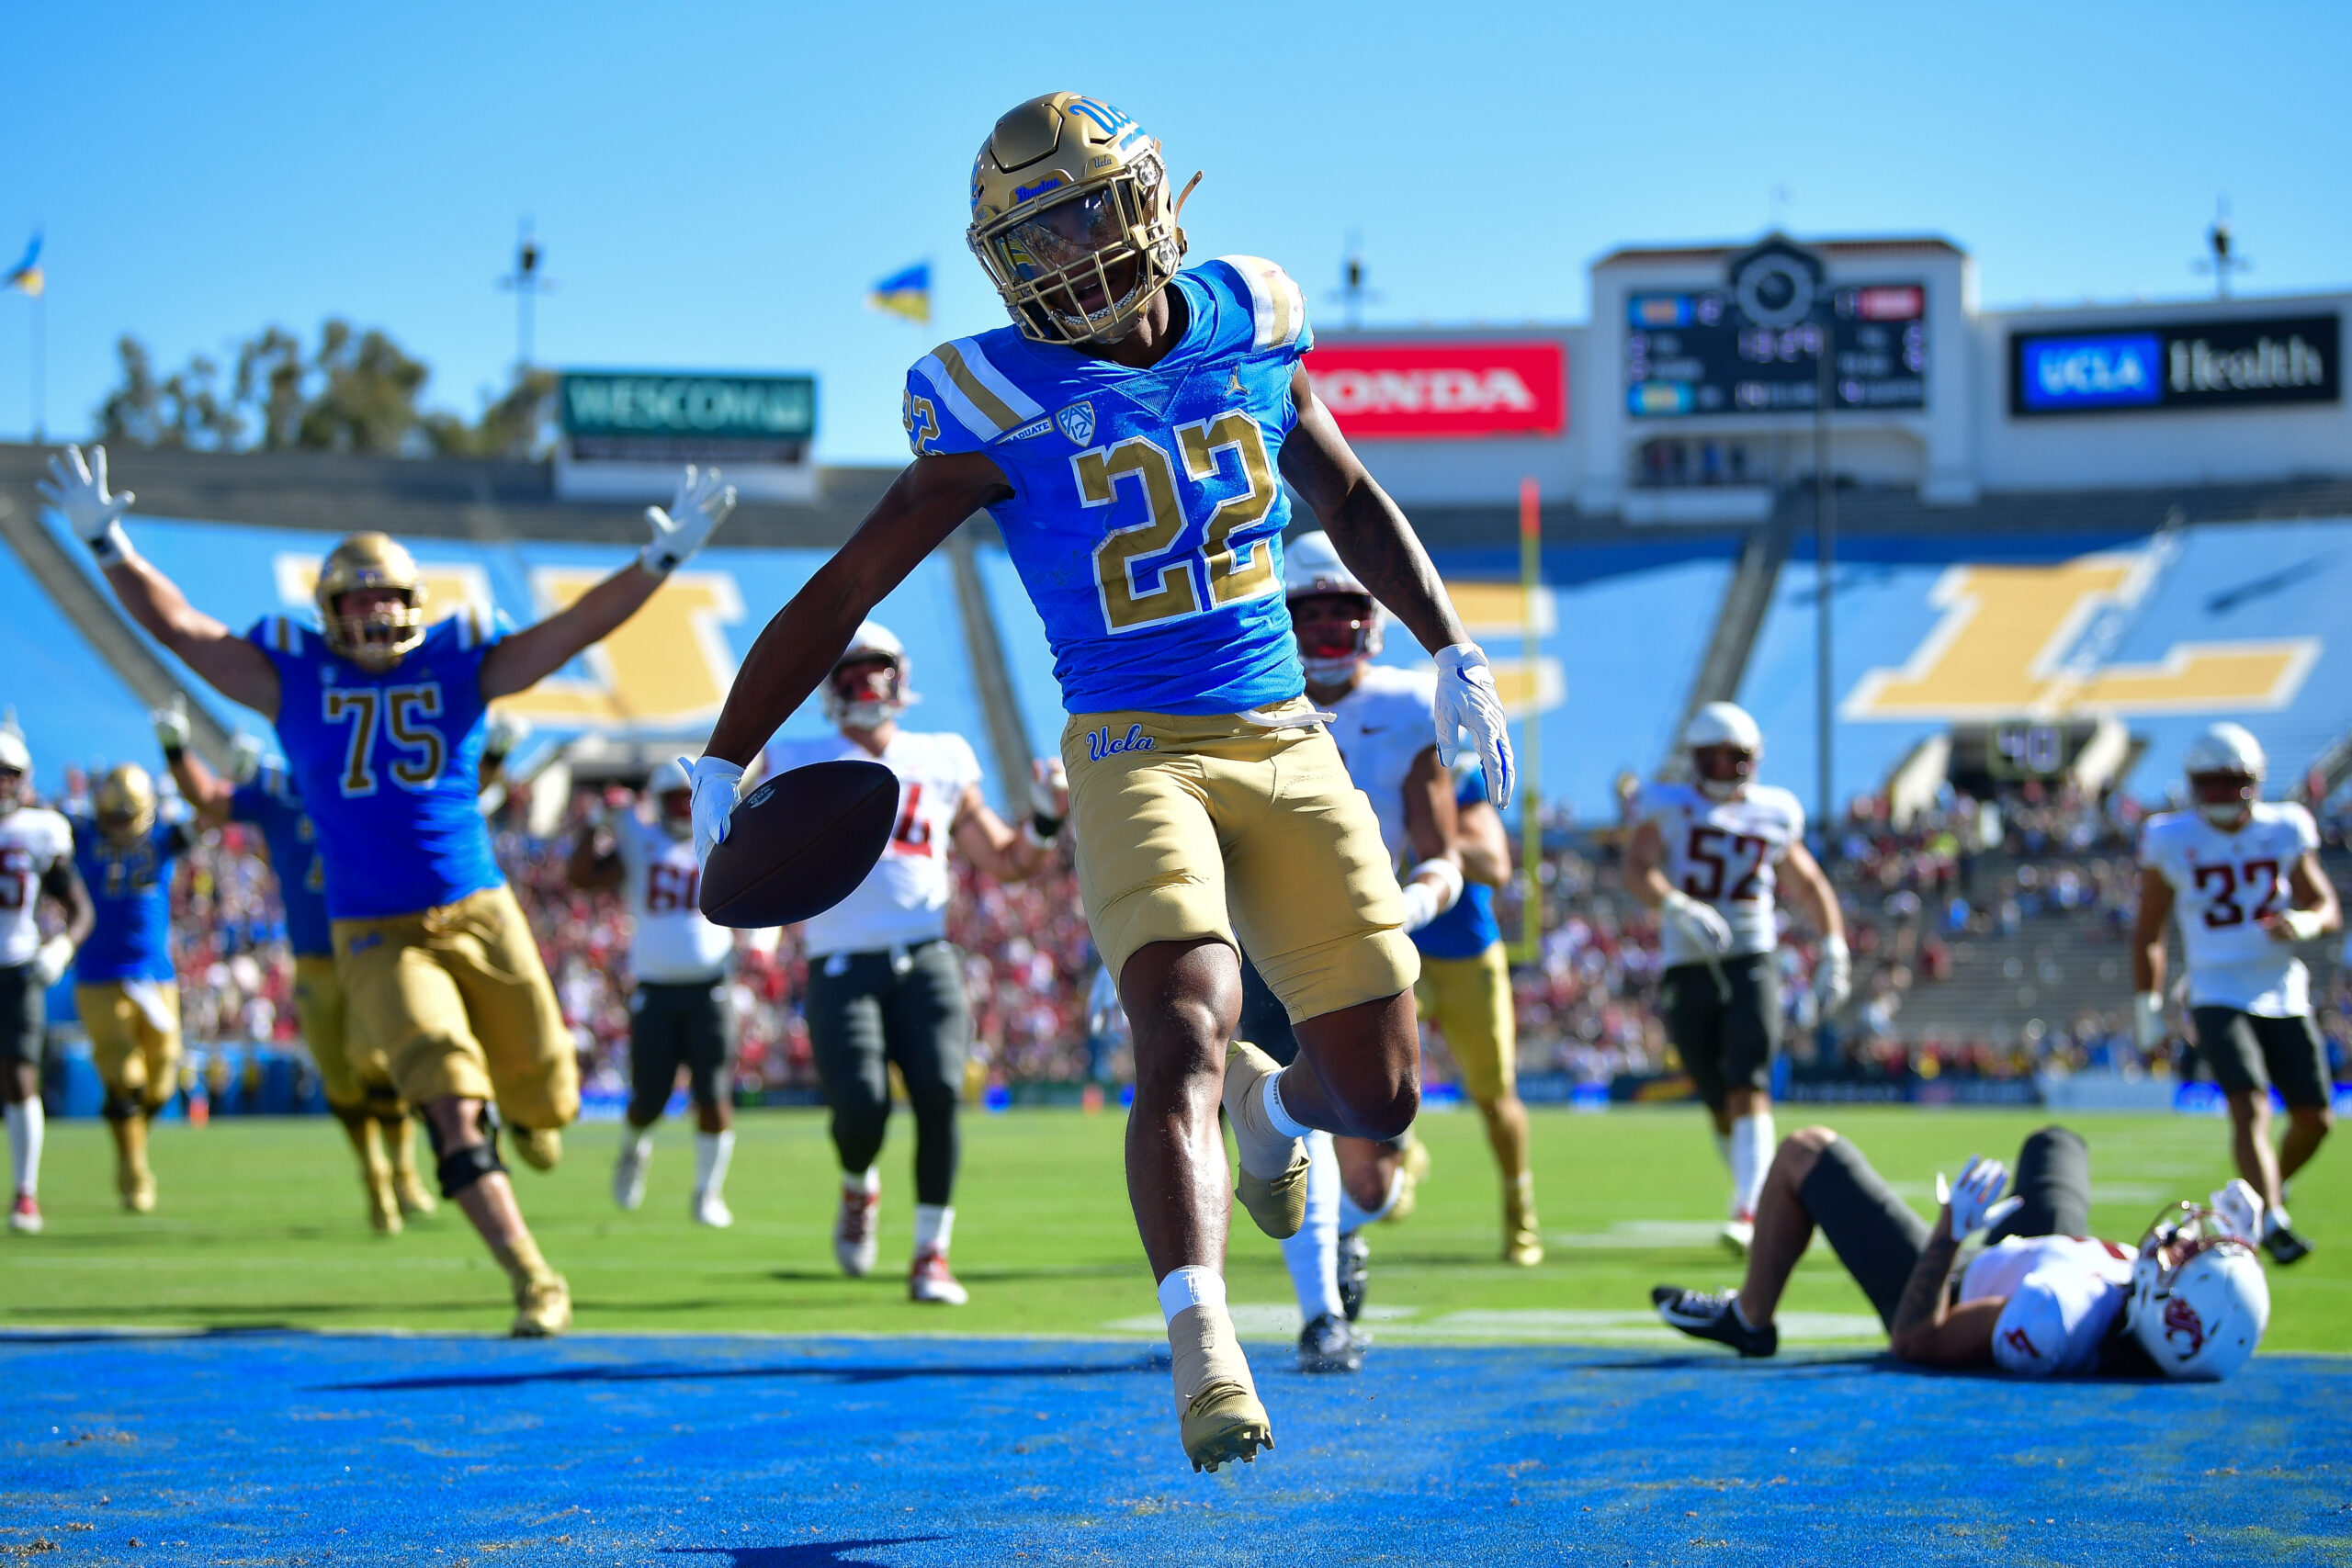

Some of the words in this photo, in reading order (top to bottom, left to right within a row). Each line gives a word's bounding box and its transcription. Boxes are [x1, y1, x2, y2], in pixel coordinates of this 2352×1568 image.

[1311, 368, 1540, 412] ONDA
[2039, 346, 2149, 395] UCLA
[2170, 335, 2324, 392] Health
[1057, 404, 1093, 434] PAC
[1071, 421, 1091, 440] 12
[1069, 408, 1282, 635] 22
[323, 682, 447, 797] 75
[1085, 724, 1158, 763] Ucla
[1684, 827, 1770, 900] 52
[2194, 860, 2278, 928] 32
